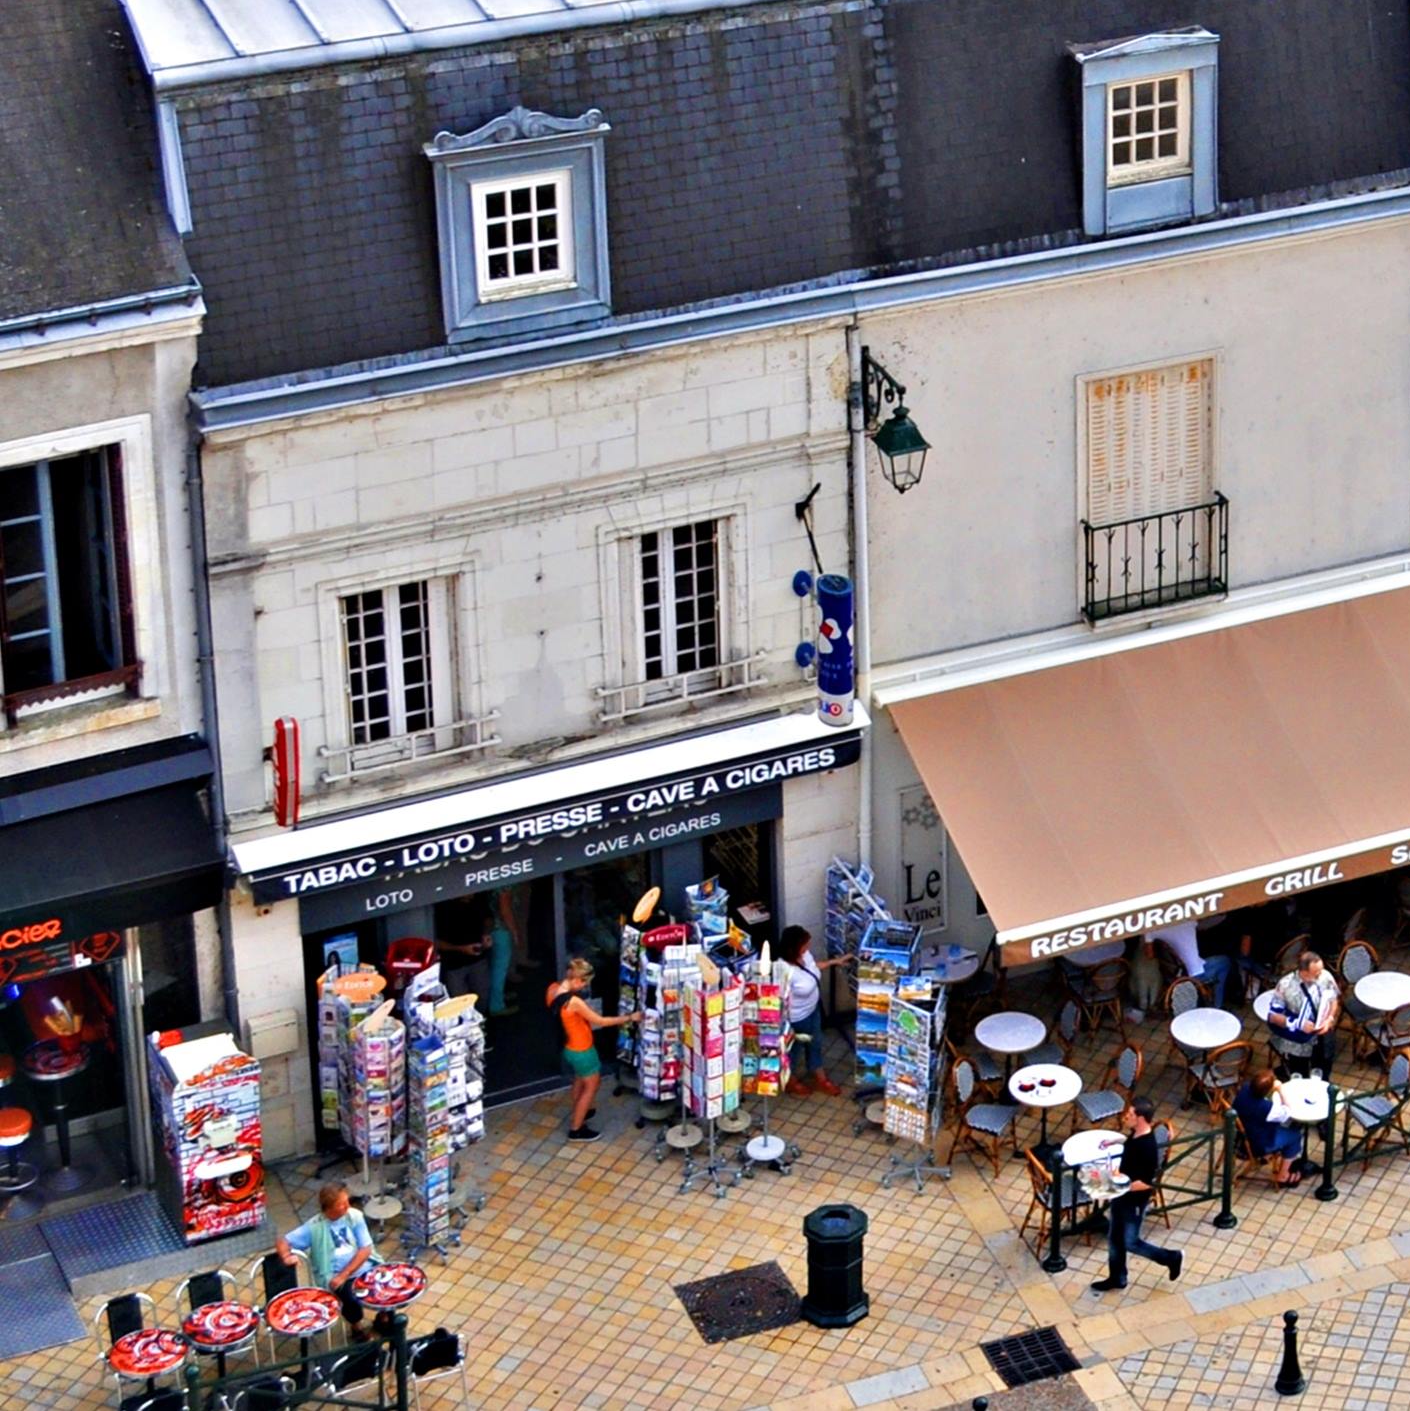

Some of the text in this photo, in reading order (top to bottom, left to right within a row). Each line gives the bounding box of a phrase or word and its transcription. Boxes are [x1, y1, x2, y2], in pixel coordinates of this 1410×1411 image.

[283, 856, 378, 894] TABAC
[402, 833, 476, 868] LOTO
[499, 803, 603, 844] PRESSE
[626, 780, 696, 814] CAVE
[700, 775, 720, 797] A
[725, 747, 837, 790] CIGARES
[365, 888, 414, 912] LOTO
[464, 858, 534, 887] PRESSE
[584, 836, 629, 858] CAVE
[632, 831, 645, 846] A
[648, 812, 722, 842] CIGARES
[903, 901, 941, 923] Vinci
[904, 863, 941, 905] Le
[1030, 892, 1224, 959] RESTAURANT
[1264, 861, 1344, 896] GRILL
